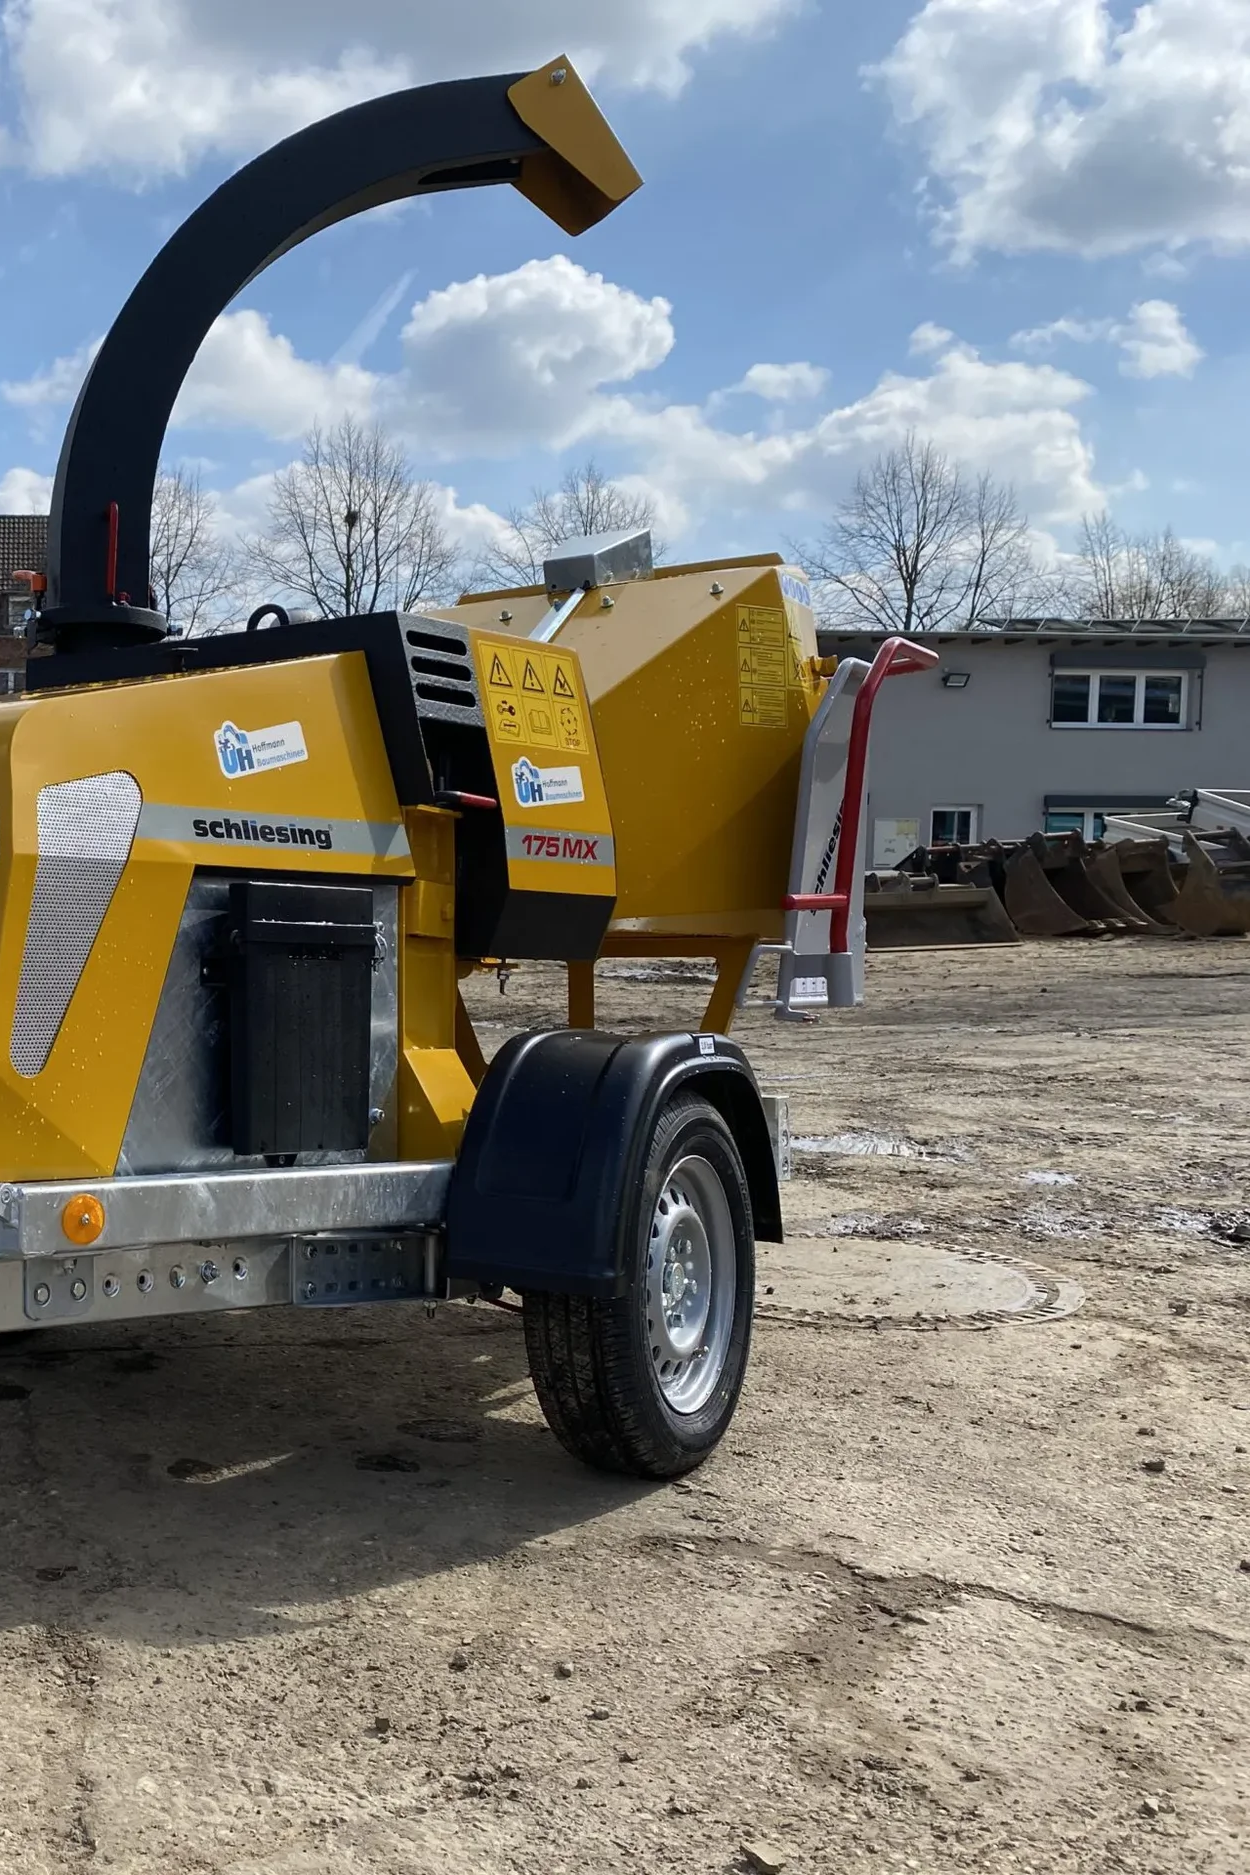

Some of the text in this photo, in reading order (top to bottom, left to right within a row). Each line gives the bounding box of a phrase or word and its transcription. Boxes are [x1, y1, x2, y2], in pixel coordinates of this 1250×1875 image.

[252, 738, 285, 752] Hoffmann
[257, 749, 305, 767] Baumaschinen
[193, 818, 333, 850] schliesing
